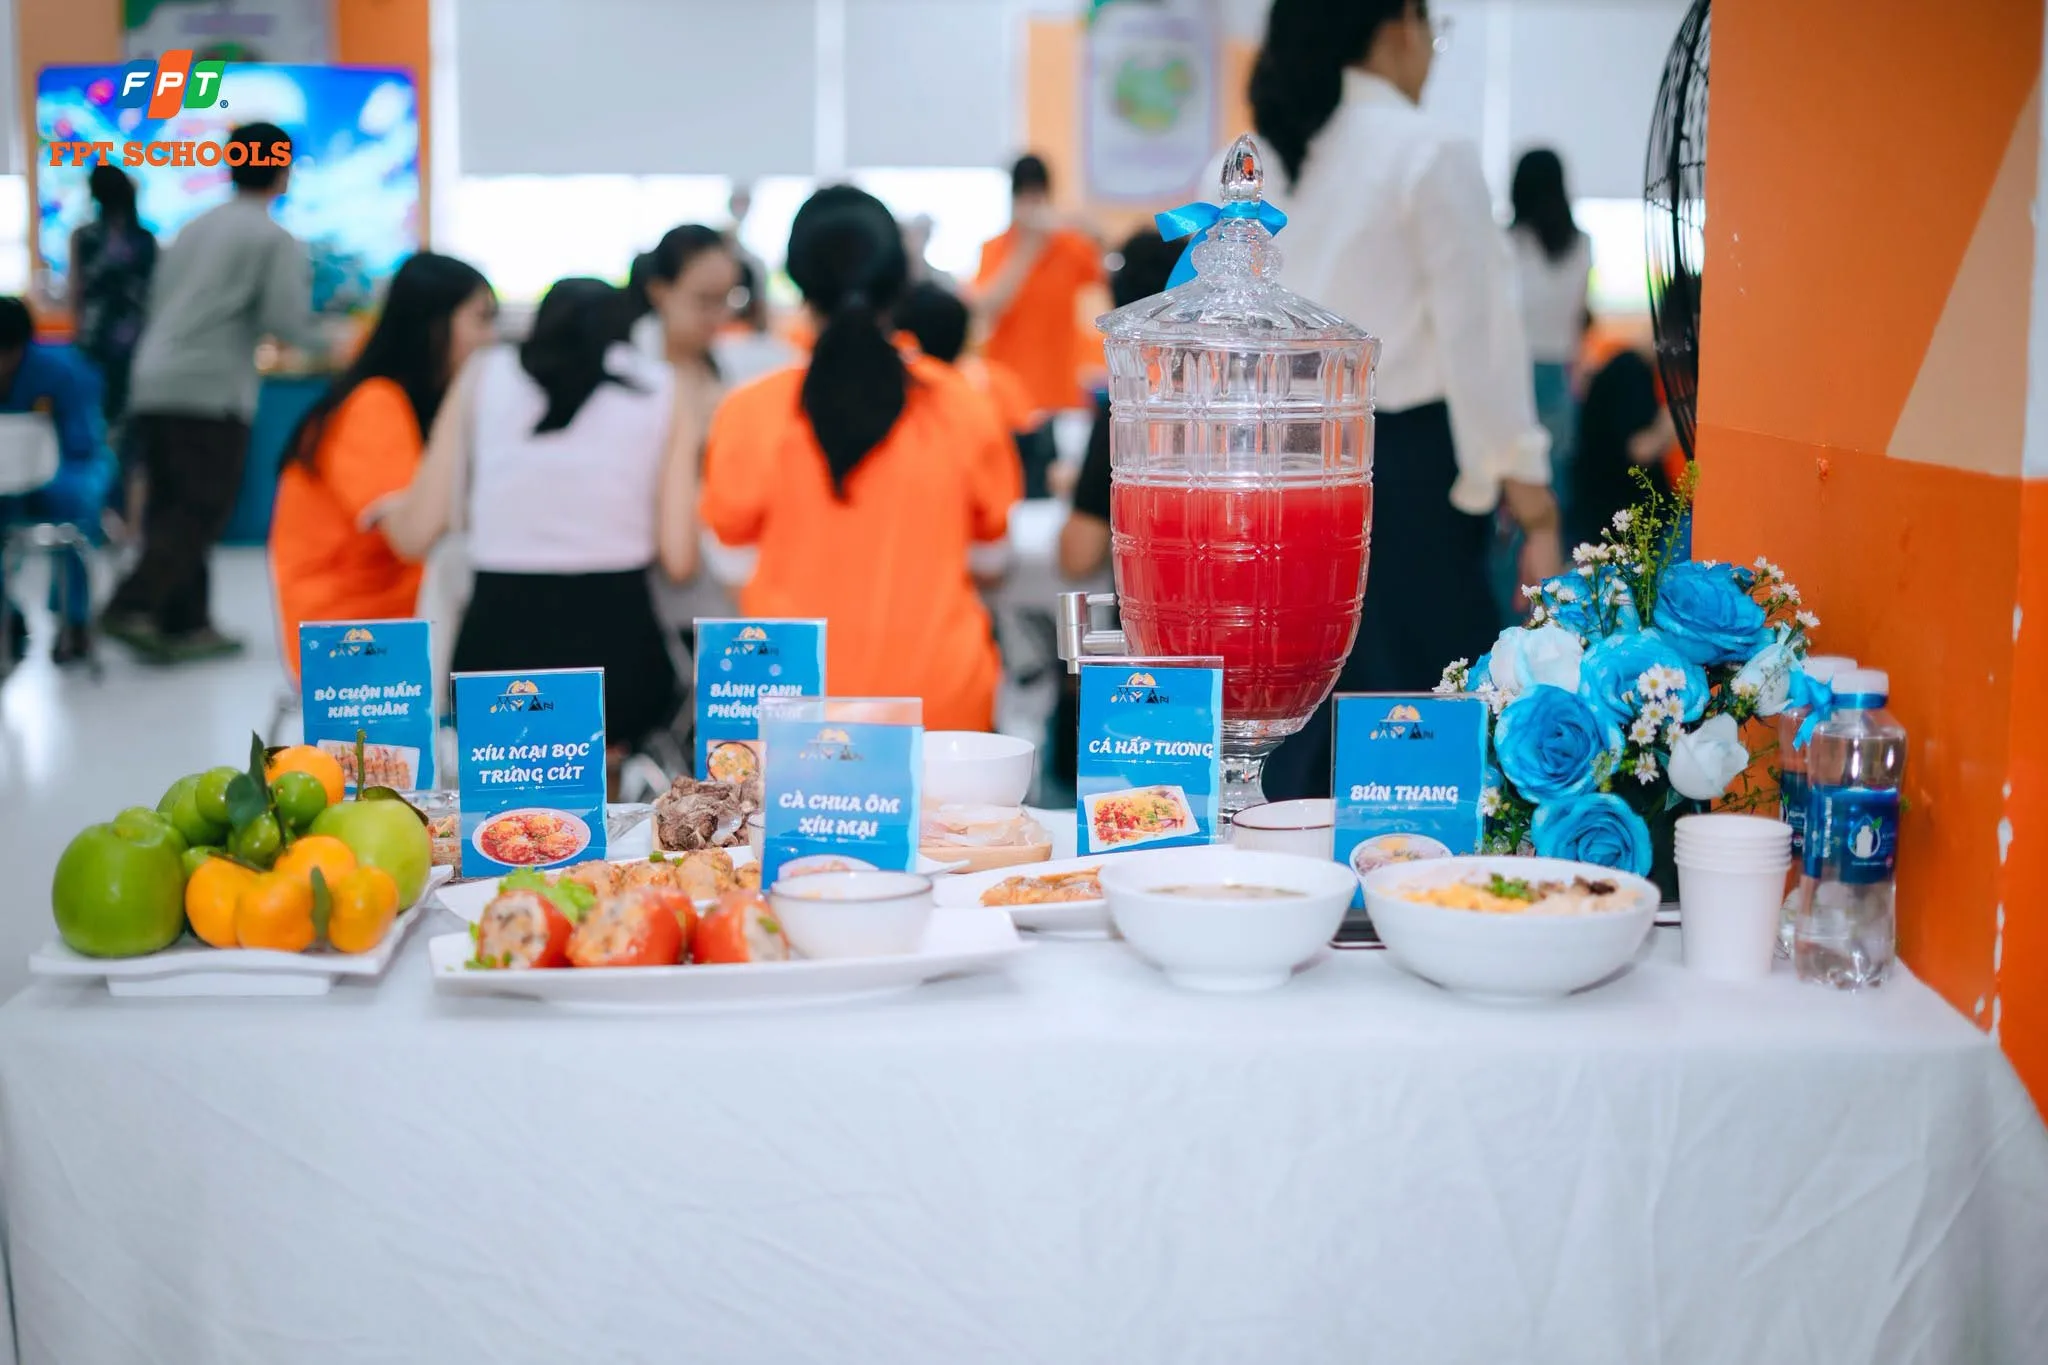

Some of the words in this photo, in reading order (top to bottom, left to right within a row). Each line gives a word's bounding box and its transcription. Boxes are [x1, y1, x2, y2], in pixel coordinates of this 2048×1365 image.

[709, 681, 756, 698] BÁNH
[327, 704, 361, 719] KIM
[471, 743, 505, 762] XÍU
[508, 743, 548, 762] MẠI
[551, 742, 590, 761] BỌC
[1088, 737, 1112, 755] CÁ
[1114, 736, 1151, 756] HẤP
[1153, 741, 1215, 760] TƯƠNG
[779, 789, 806, 809] CÀ
[808, 794, 862, 813] CHUA
[1350, 781, 1390, 801] BÚN
[1394, 785, 1459, 805] THANG
